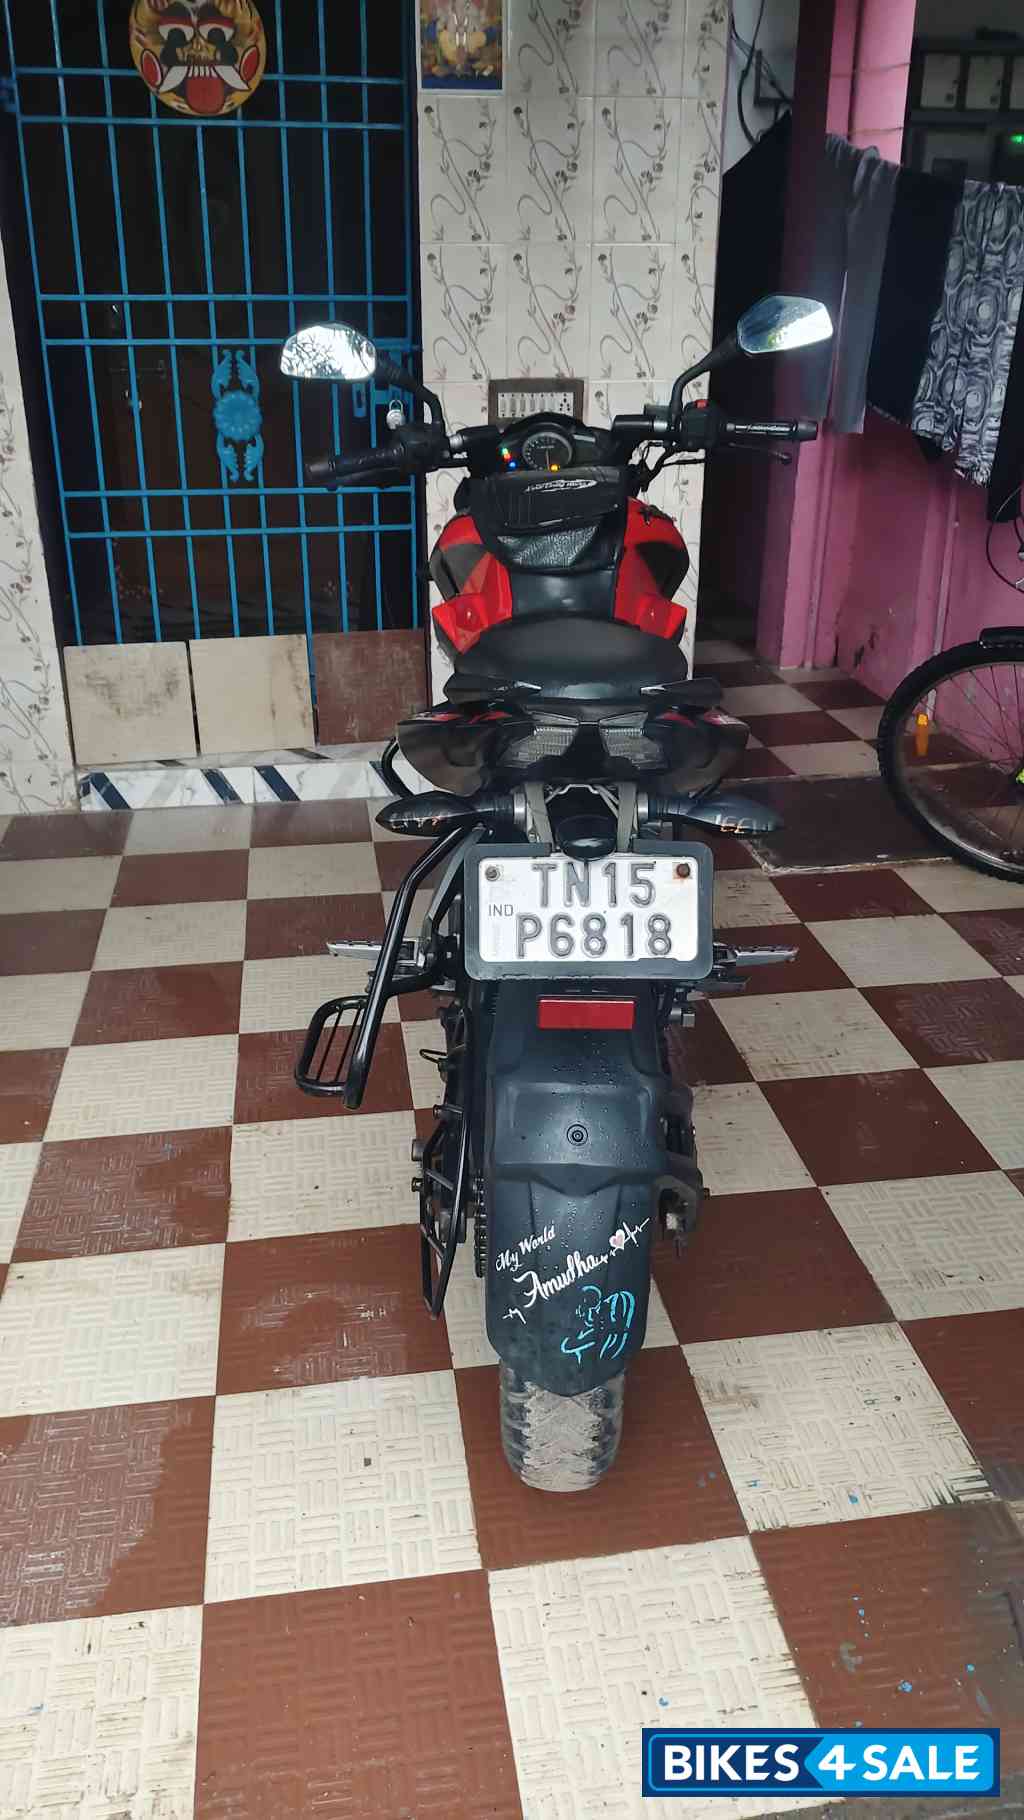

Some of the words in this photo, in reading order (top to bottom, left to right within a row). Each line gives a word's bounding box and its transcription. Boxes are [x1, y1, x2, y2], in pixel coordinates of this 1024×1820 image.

[532, 862, 656, 908] TN15
[488, 904, 514, 917] IND
[516, 912, 673, 958] P6818
[495, 1249, 523, 1272] My
[518, 1223, 556, 1255] World
